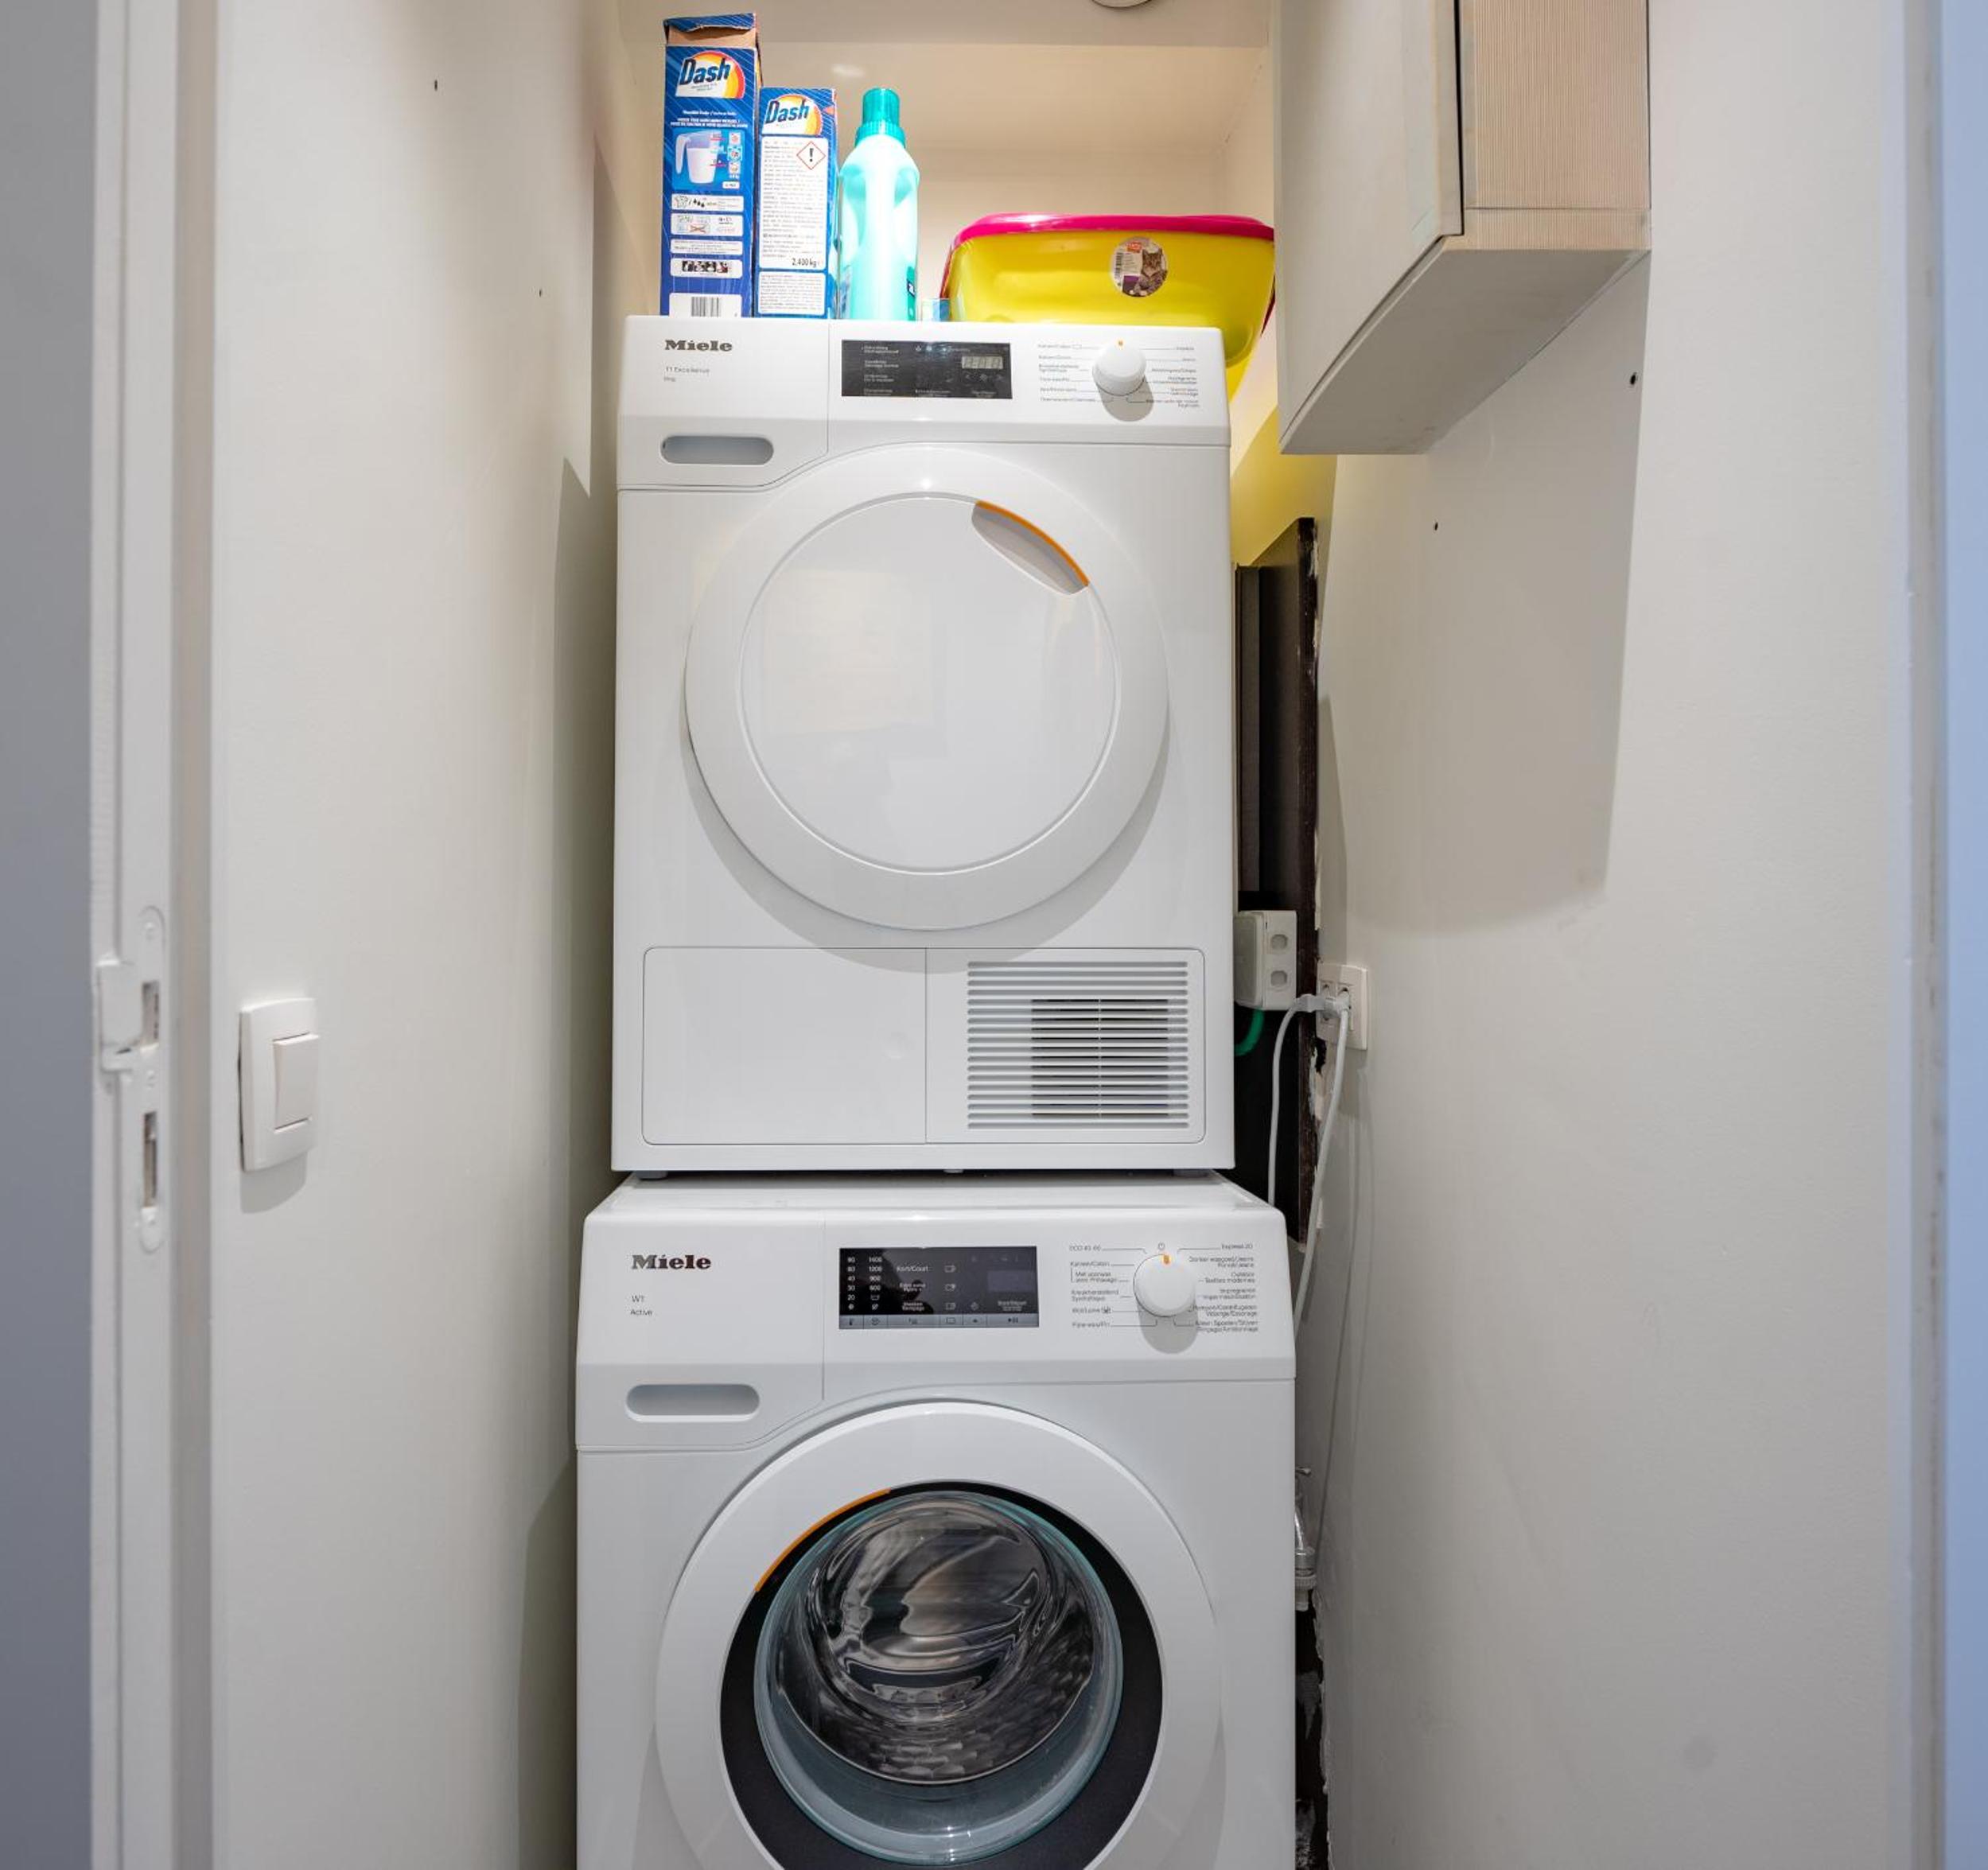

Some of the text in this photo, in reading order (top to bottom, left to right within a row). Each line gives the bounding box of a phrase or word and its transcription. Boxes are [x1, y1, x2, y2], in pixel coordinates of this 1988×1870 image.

[679, 57, 731, 86] Dash
[764, 99, 810, 124] Dash
[809, 258, 817, 268] kg
[664, 339, 733, 352] Miele
[632, 1254, 711, 1269] Miele
